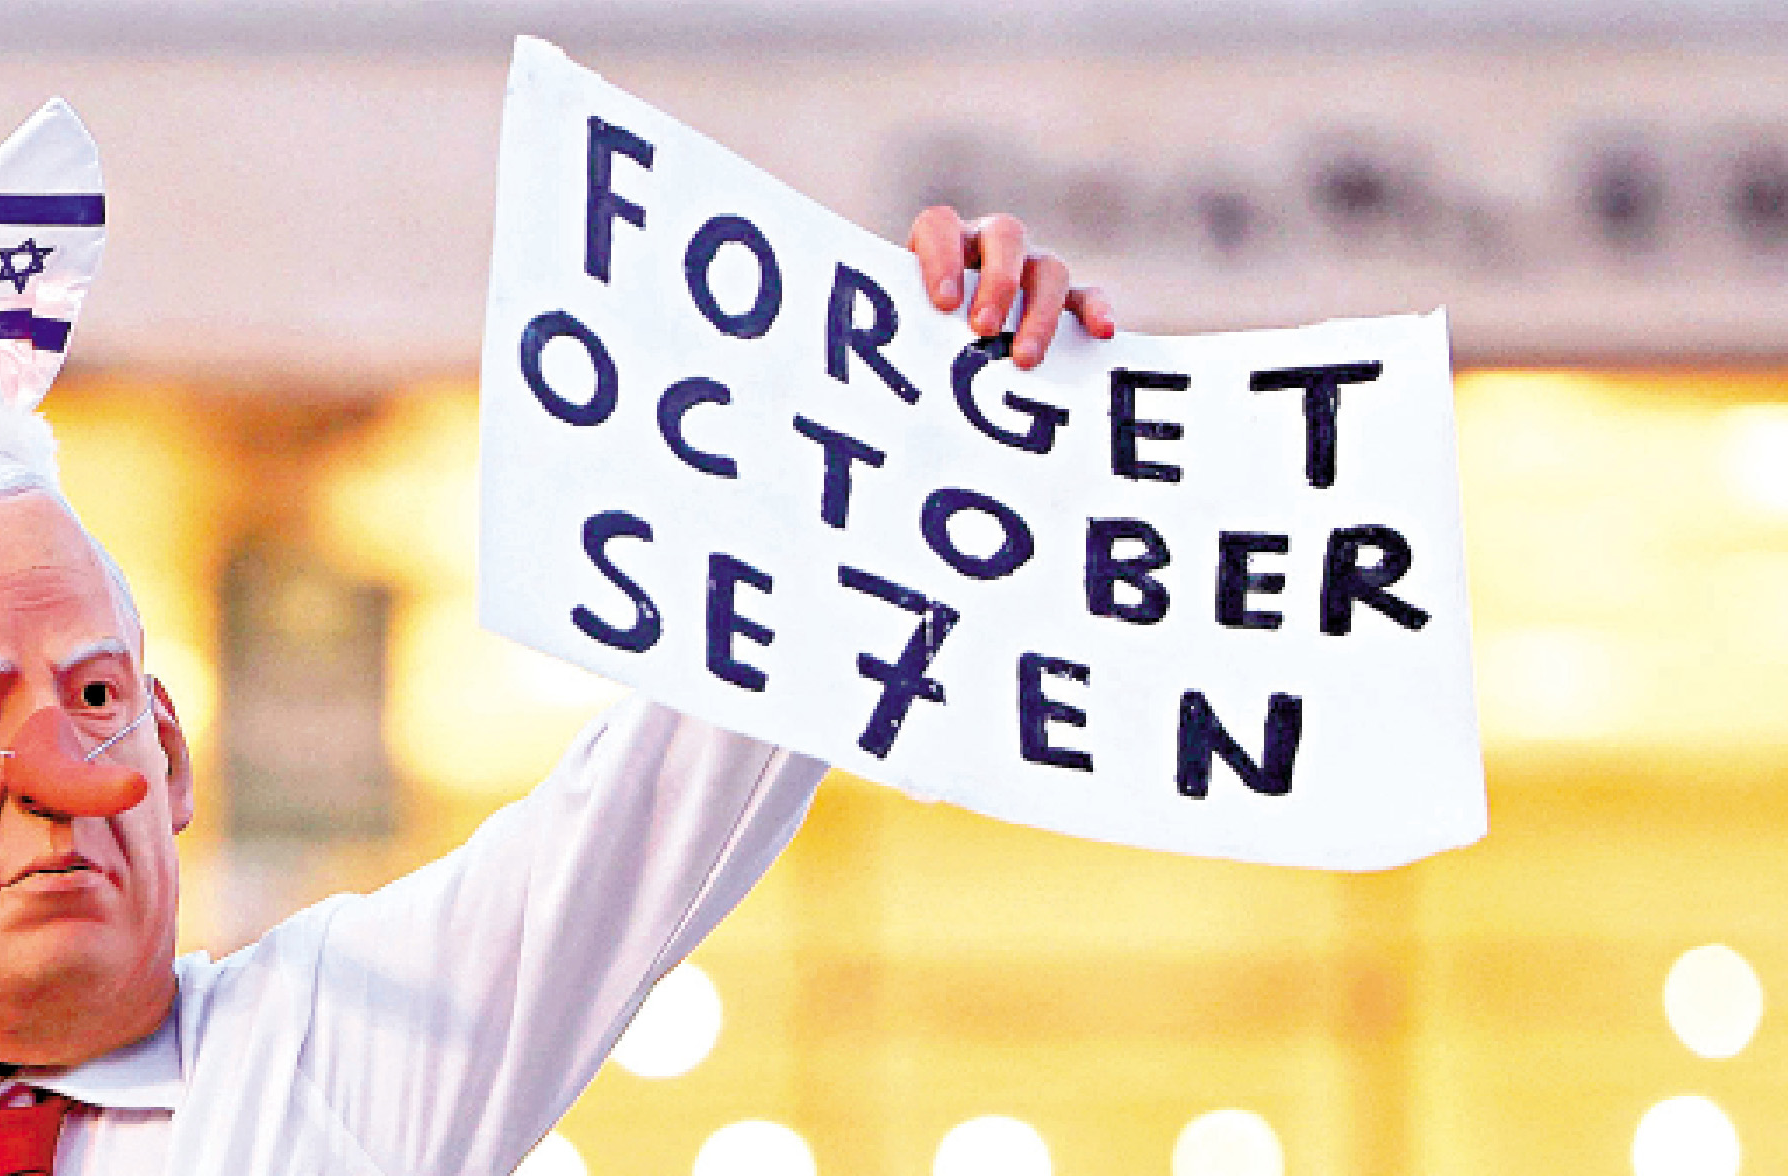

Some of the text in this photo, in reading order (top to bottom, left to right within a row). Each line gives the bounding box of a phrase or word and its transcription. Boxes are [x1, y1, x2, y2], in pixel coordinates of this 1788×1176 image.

[584, 115, 1385, 490] FORGET
[520, 309, 1433, 638] OCTOBER
[571, 511, 1303, 801] SE7EN
